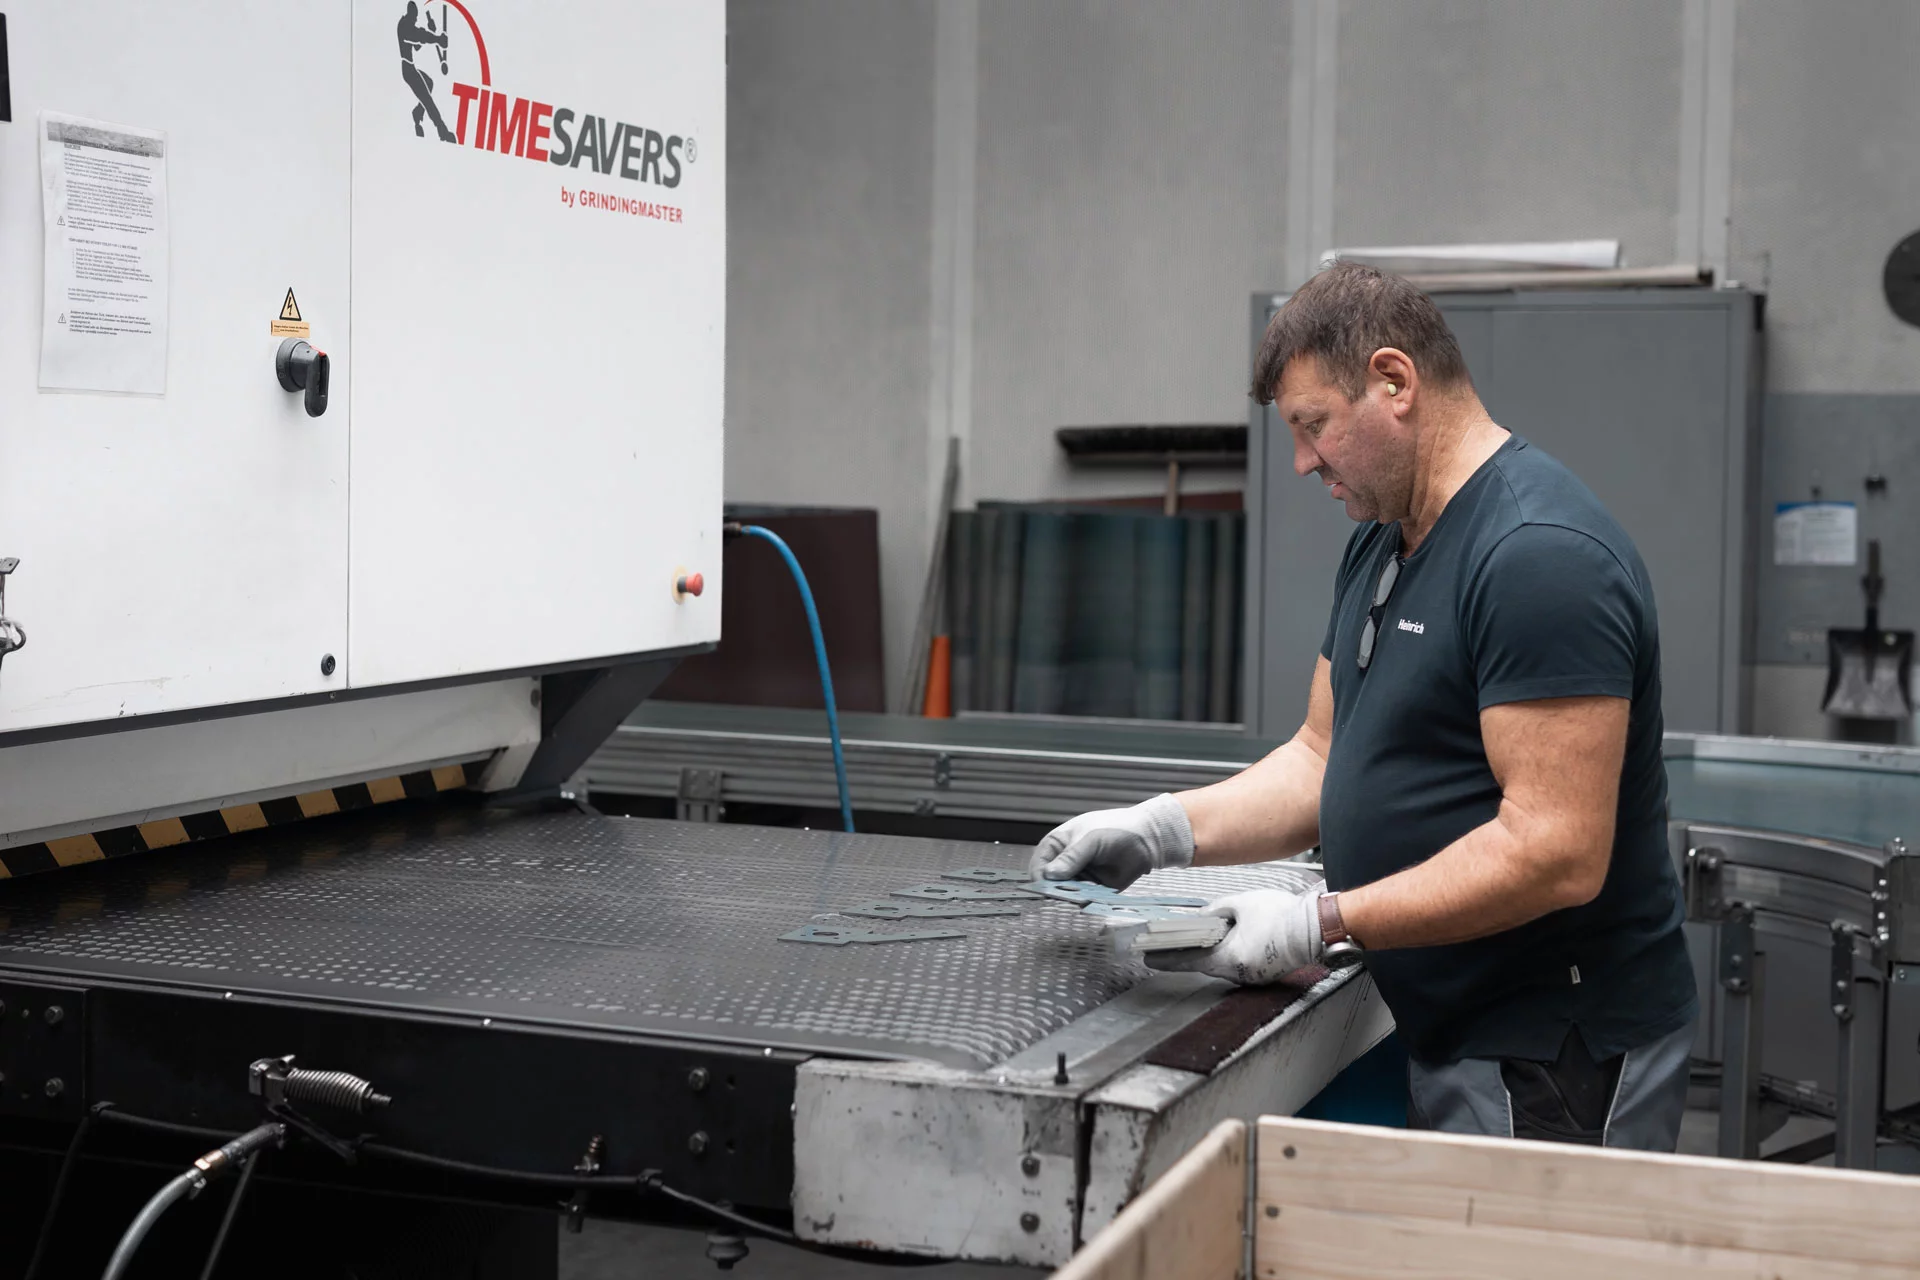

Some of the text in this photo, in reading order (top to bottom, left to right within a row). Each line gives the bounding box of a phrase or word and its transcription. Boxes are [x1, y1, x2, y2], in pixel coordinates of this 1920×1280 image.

[561, 186, 683, 224] by GRINDINGMASTER
[1397, 618, 1424, 634] Heinrich
